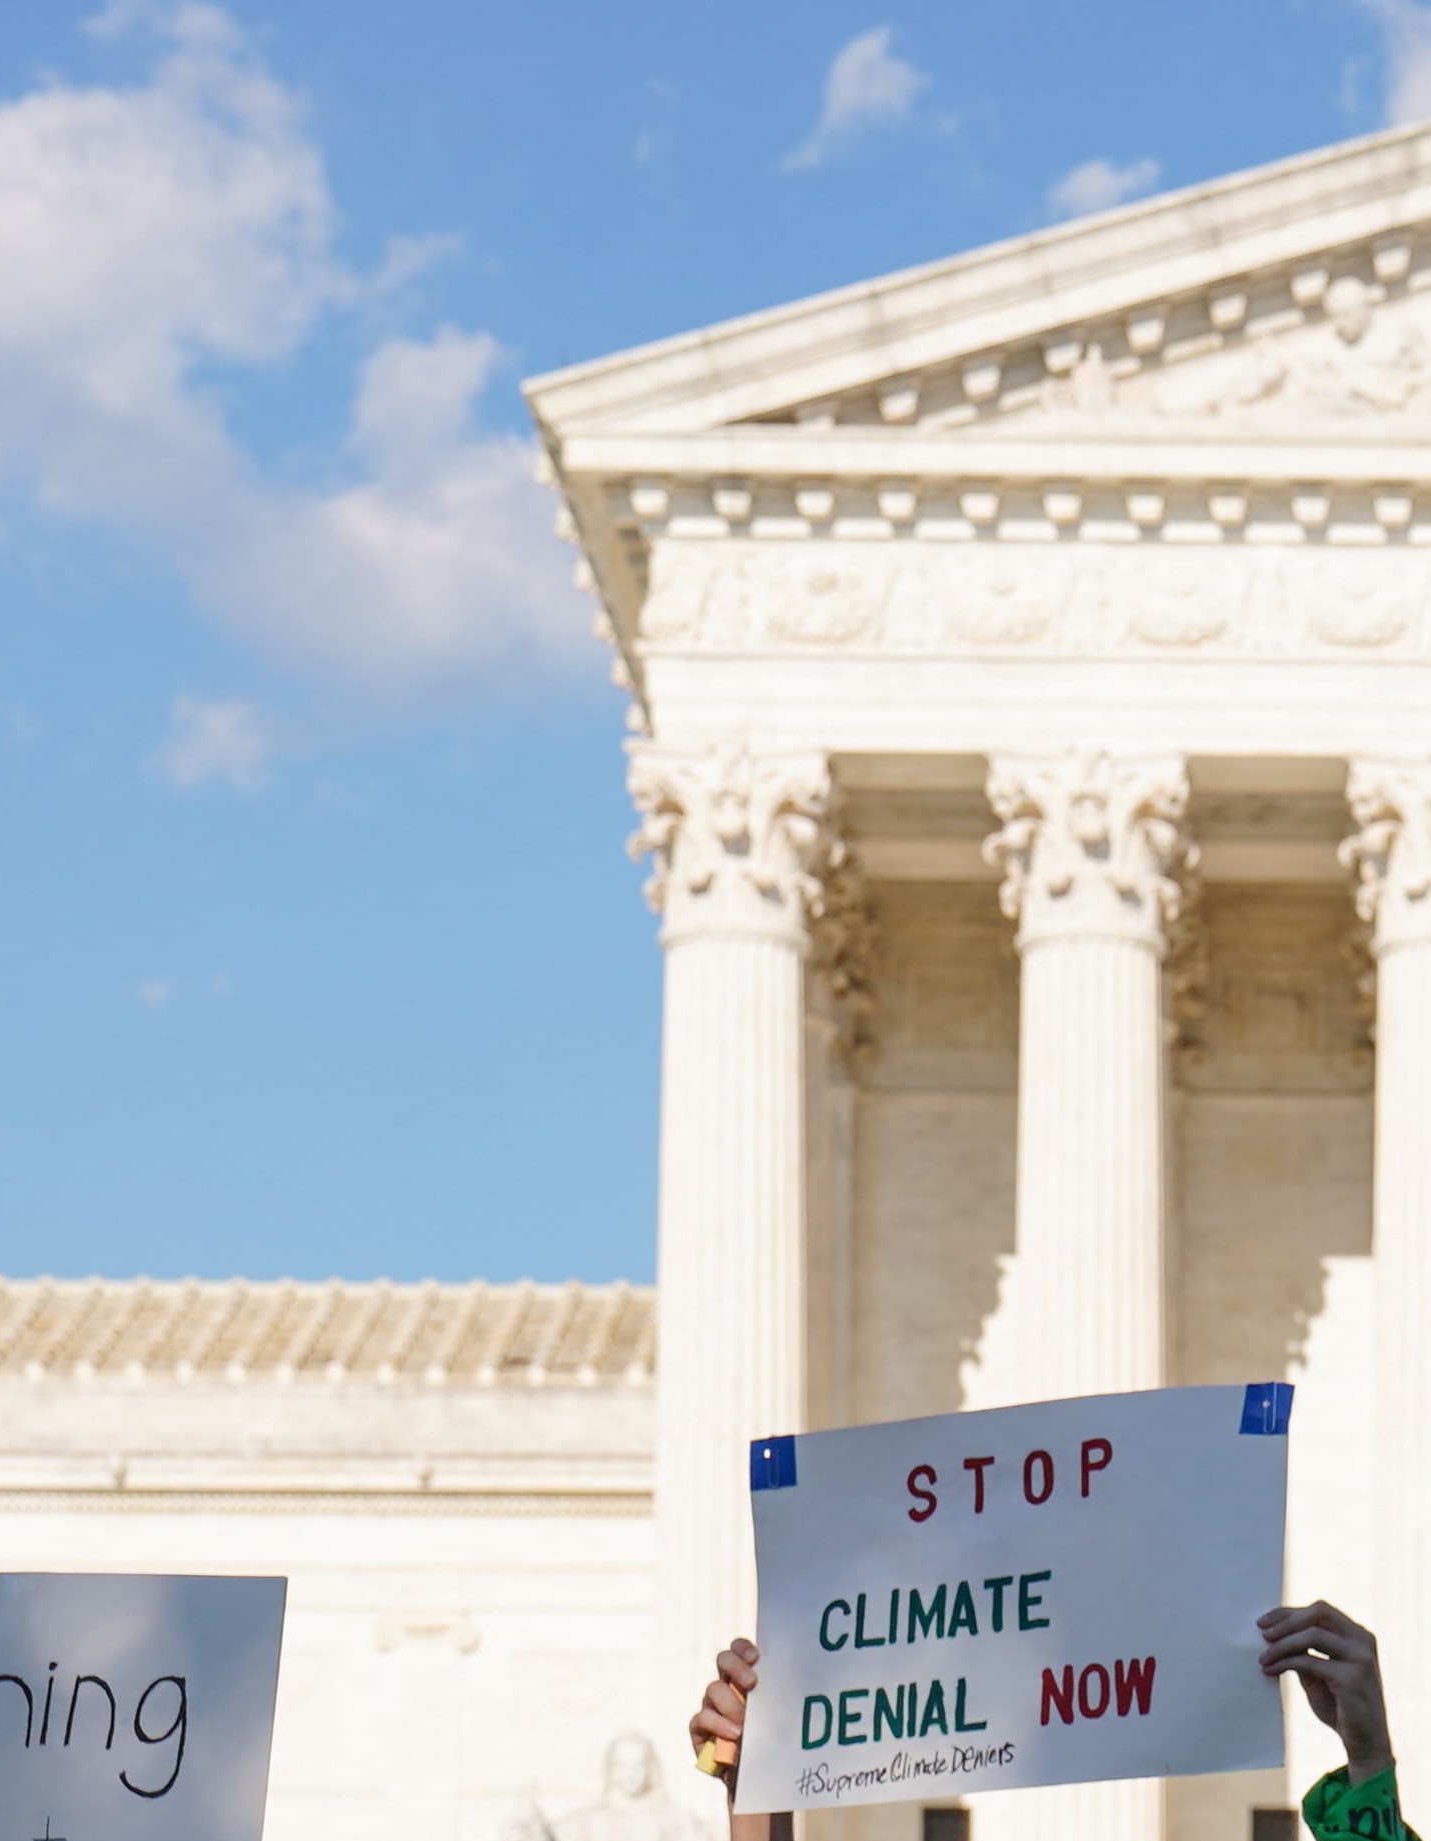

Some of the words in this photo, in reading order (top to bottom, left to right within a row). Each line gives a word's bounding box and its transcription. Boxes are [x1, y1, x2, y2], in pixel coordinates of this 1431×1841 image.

[906, 1437, 1114, 1523] STOP
[819, 1570, 1051, 1651] CLIMATE
[801, 1676, 987, 1750] DENIAL
[1039, 1656, 1156, 1727] NOW
